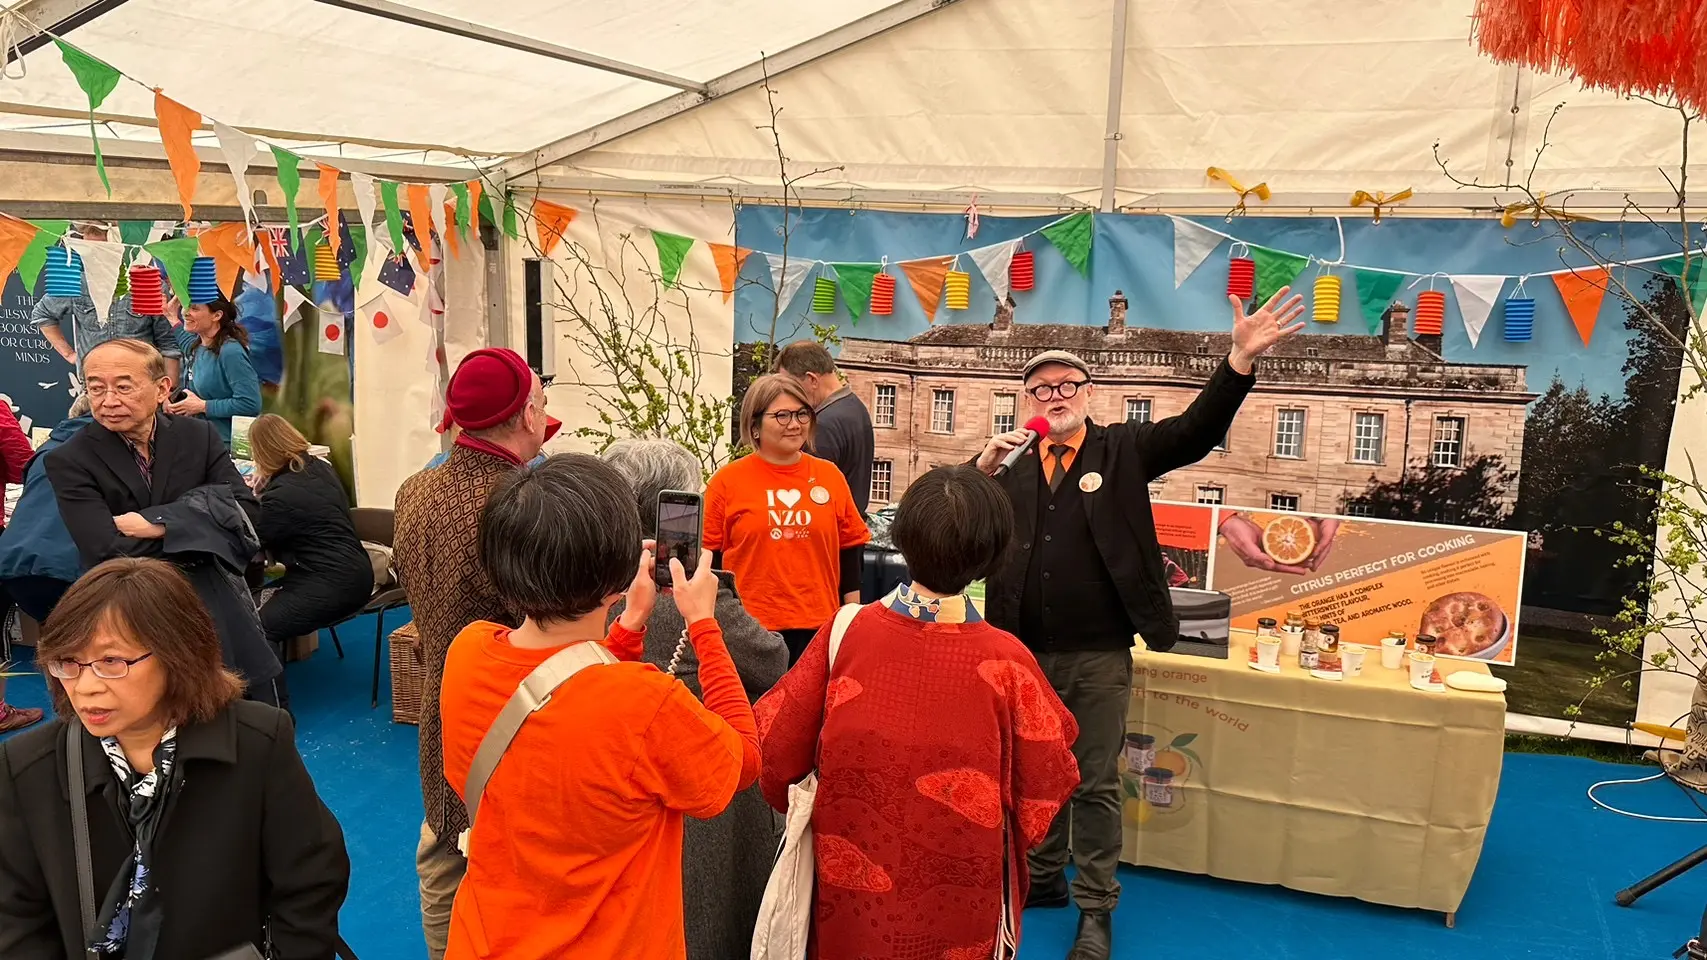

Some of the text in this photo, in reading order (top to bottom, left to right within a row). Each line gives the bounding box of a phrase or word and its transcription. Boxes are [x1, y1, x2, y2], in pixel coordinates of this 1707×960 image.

[0, 336, 54, 351] OR CURIO
[15, 351, 51, 364] MINDS
[766, 489, 776, 507] I
[768, 509, 812, 526] NZO
[1290, 574, 1334, 594] CITRUS
[1335, 559, 1389, 583] PERFECT
[1390, 551, 1416, 567] FOR
[1417, 534, 1476, 558] COOKING
[1298, 602, 1311, 611] THE
[1311, 595, 1335, 608] ORANGE
[1335, 591, 1349, 600] HAS
[1354, 582, 1384, 595] COMPLEX
[1319, 611, 1337, 621] HINTS
[1336, 608, 1345, 616] OF
[1347, 612, 1360, 621] AND
[1361, 604, 1392, 618] AROMATIC
[1134, 666, 1208, 684] ang orange
[1132, 685, 1250, 733] ift to the world
